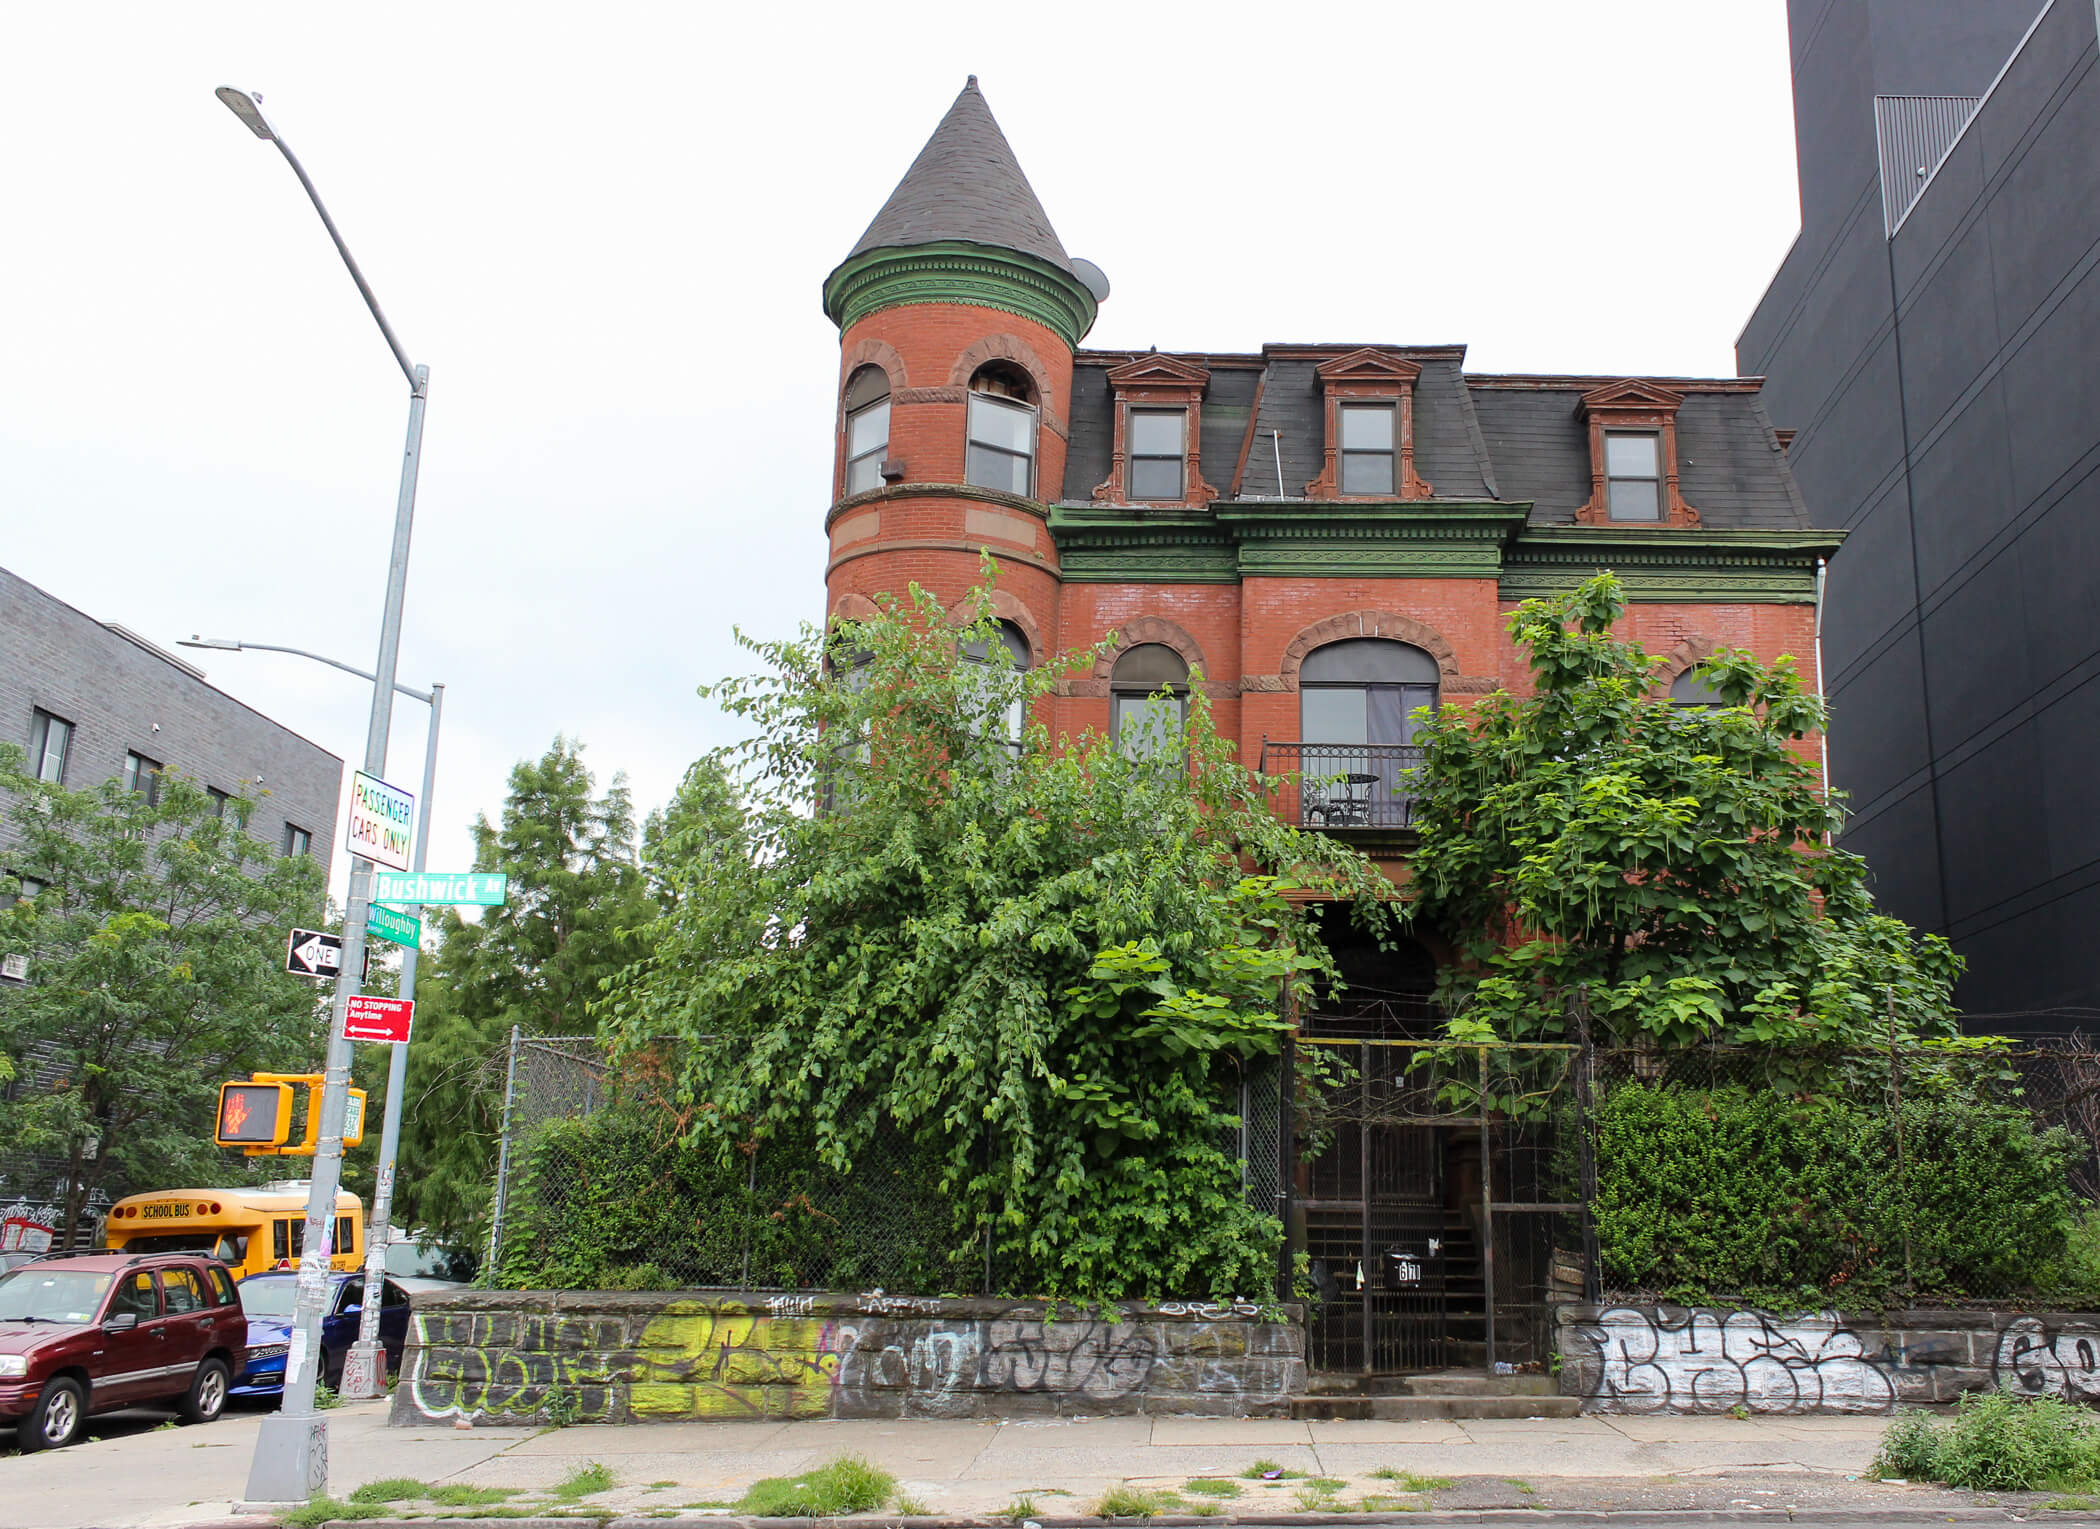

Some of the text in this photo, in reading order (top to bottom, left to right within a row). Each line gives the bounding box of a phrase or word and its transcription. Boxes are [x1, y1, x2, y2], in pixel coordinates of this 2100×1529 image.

[355, 783, 410, 826] PASSENGER
[352, 815, 408, 856] CARS ONLY
[379, 874, 478, 900] Bushwick
[368, 905, 416, 940] Willoughby
[306, 945, 333, 964] ONE
[350, 1000, 402, 1012] NO STOPPING
[350, 1010, 383, 1020] Anytime
[143, 1204, 190, 1218] SCHOOL BUS
